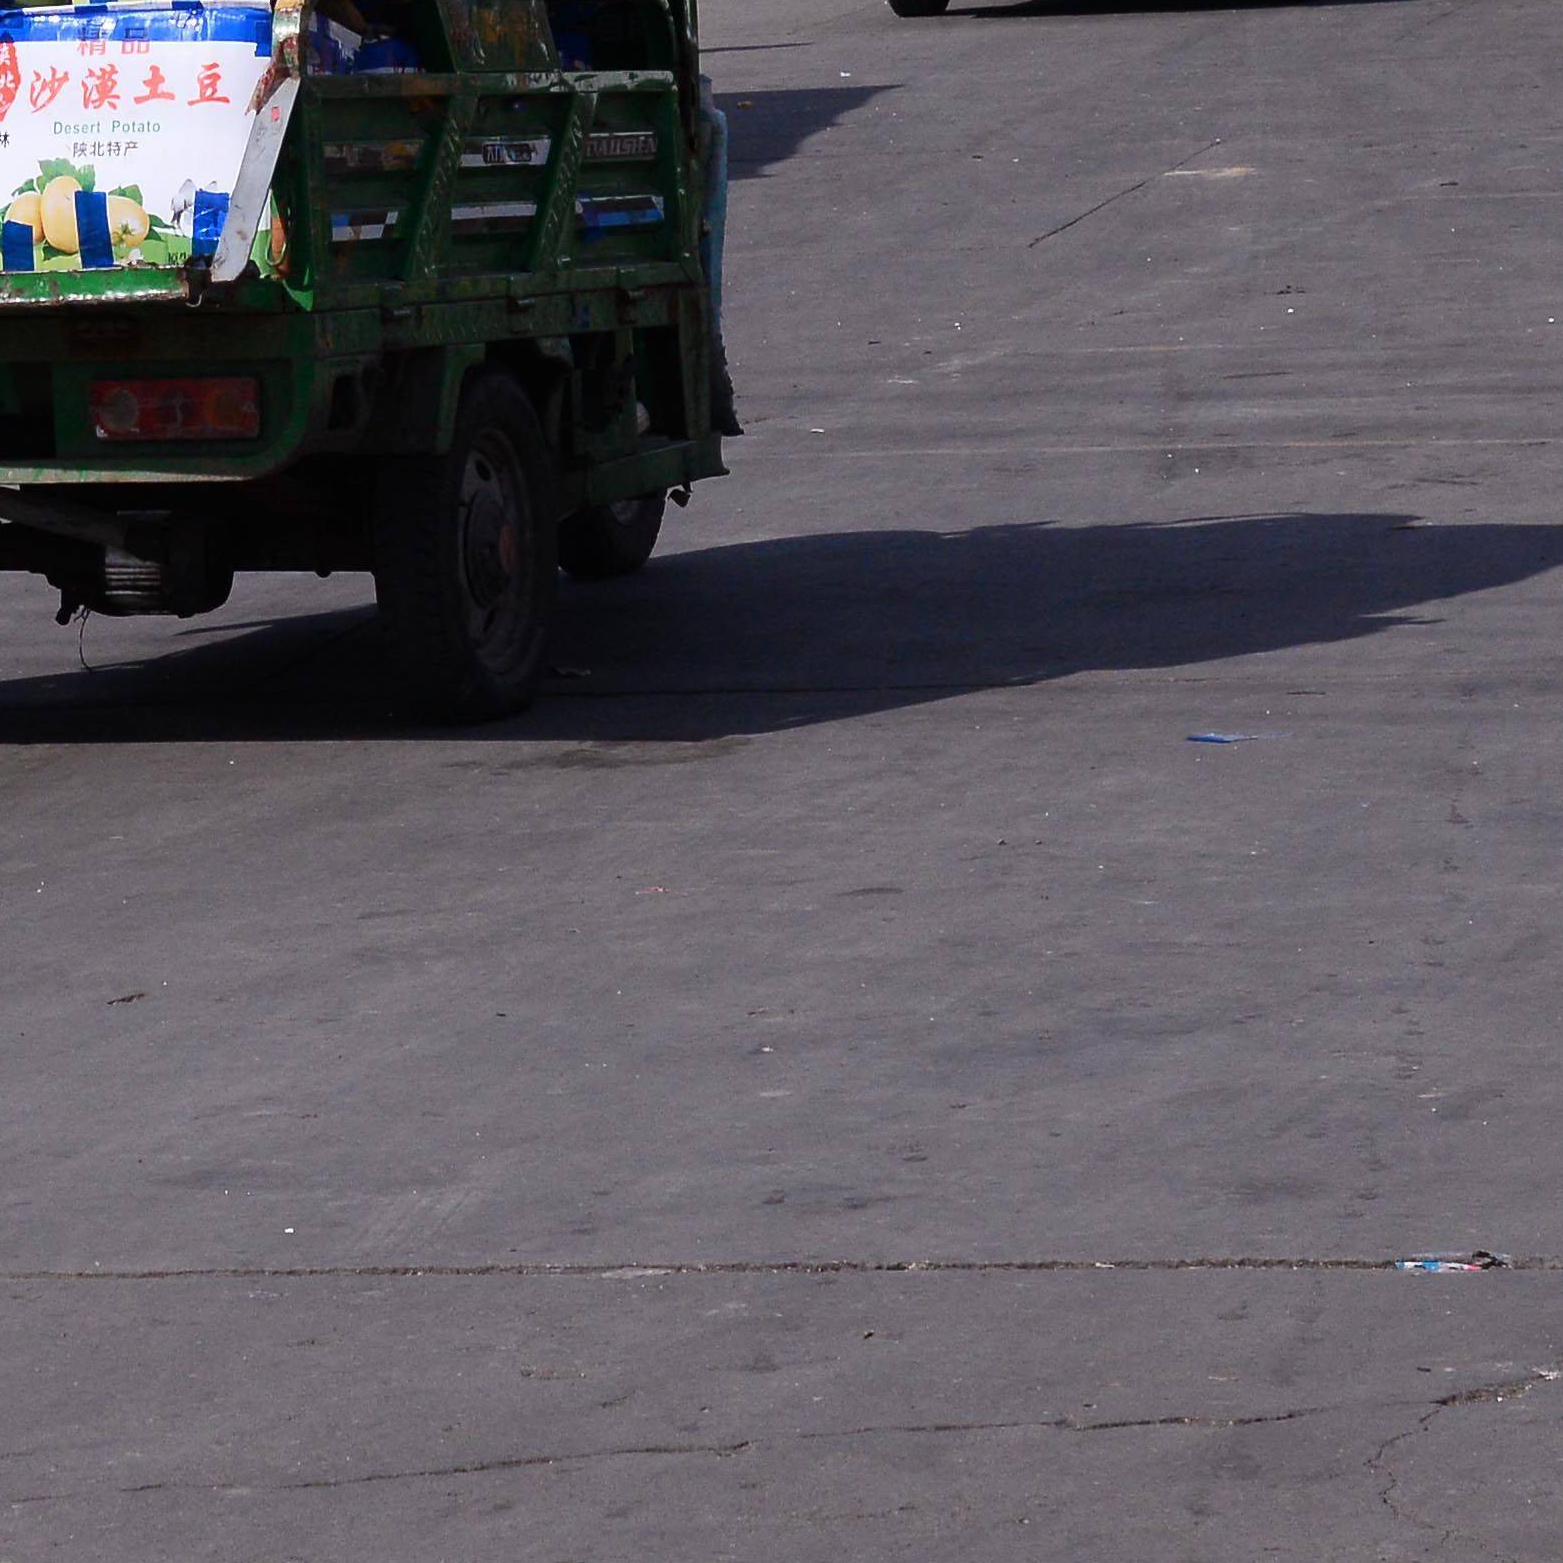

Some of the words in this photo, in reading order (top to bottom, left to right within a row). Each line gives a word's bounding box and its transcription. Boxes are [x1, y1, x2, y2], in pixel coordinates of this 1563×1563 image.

[77, 26, 150, 56] 精品
[30, 62, 230, 113] 沙漠土豆
[53, 120, 101, 135] Desert
[111, 120, 161, 134] Potato
[73, 141, 139, 157] 陕北特产
